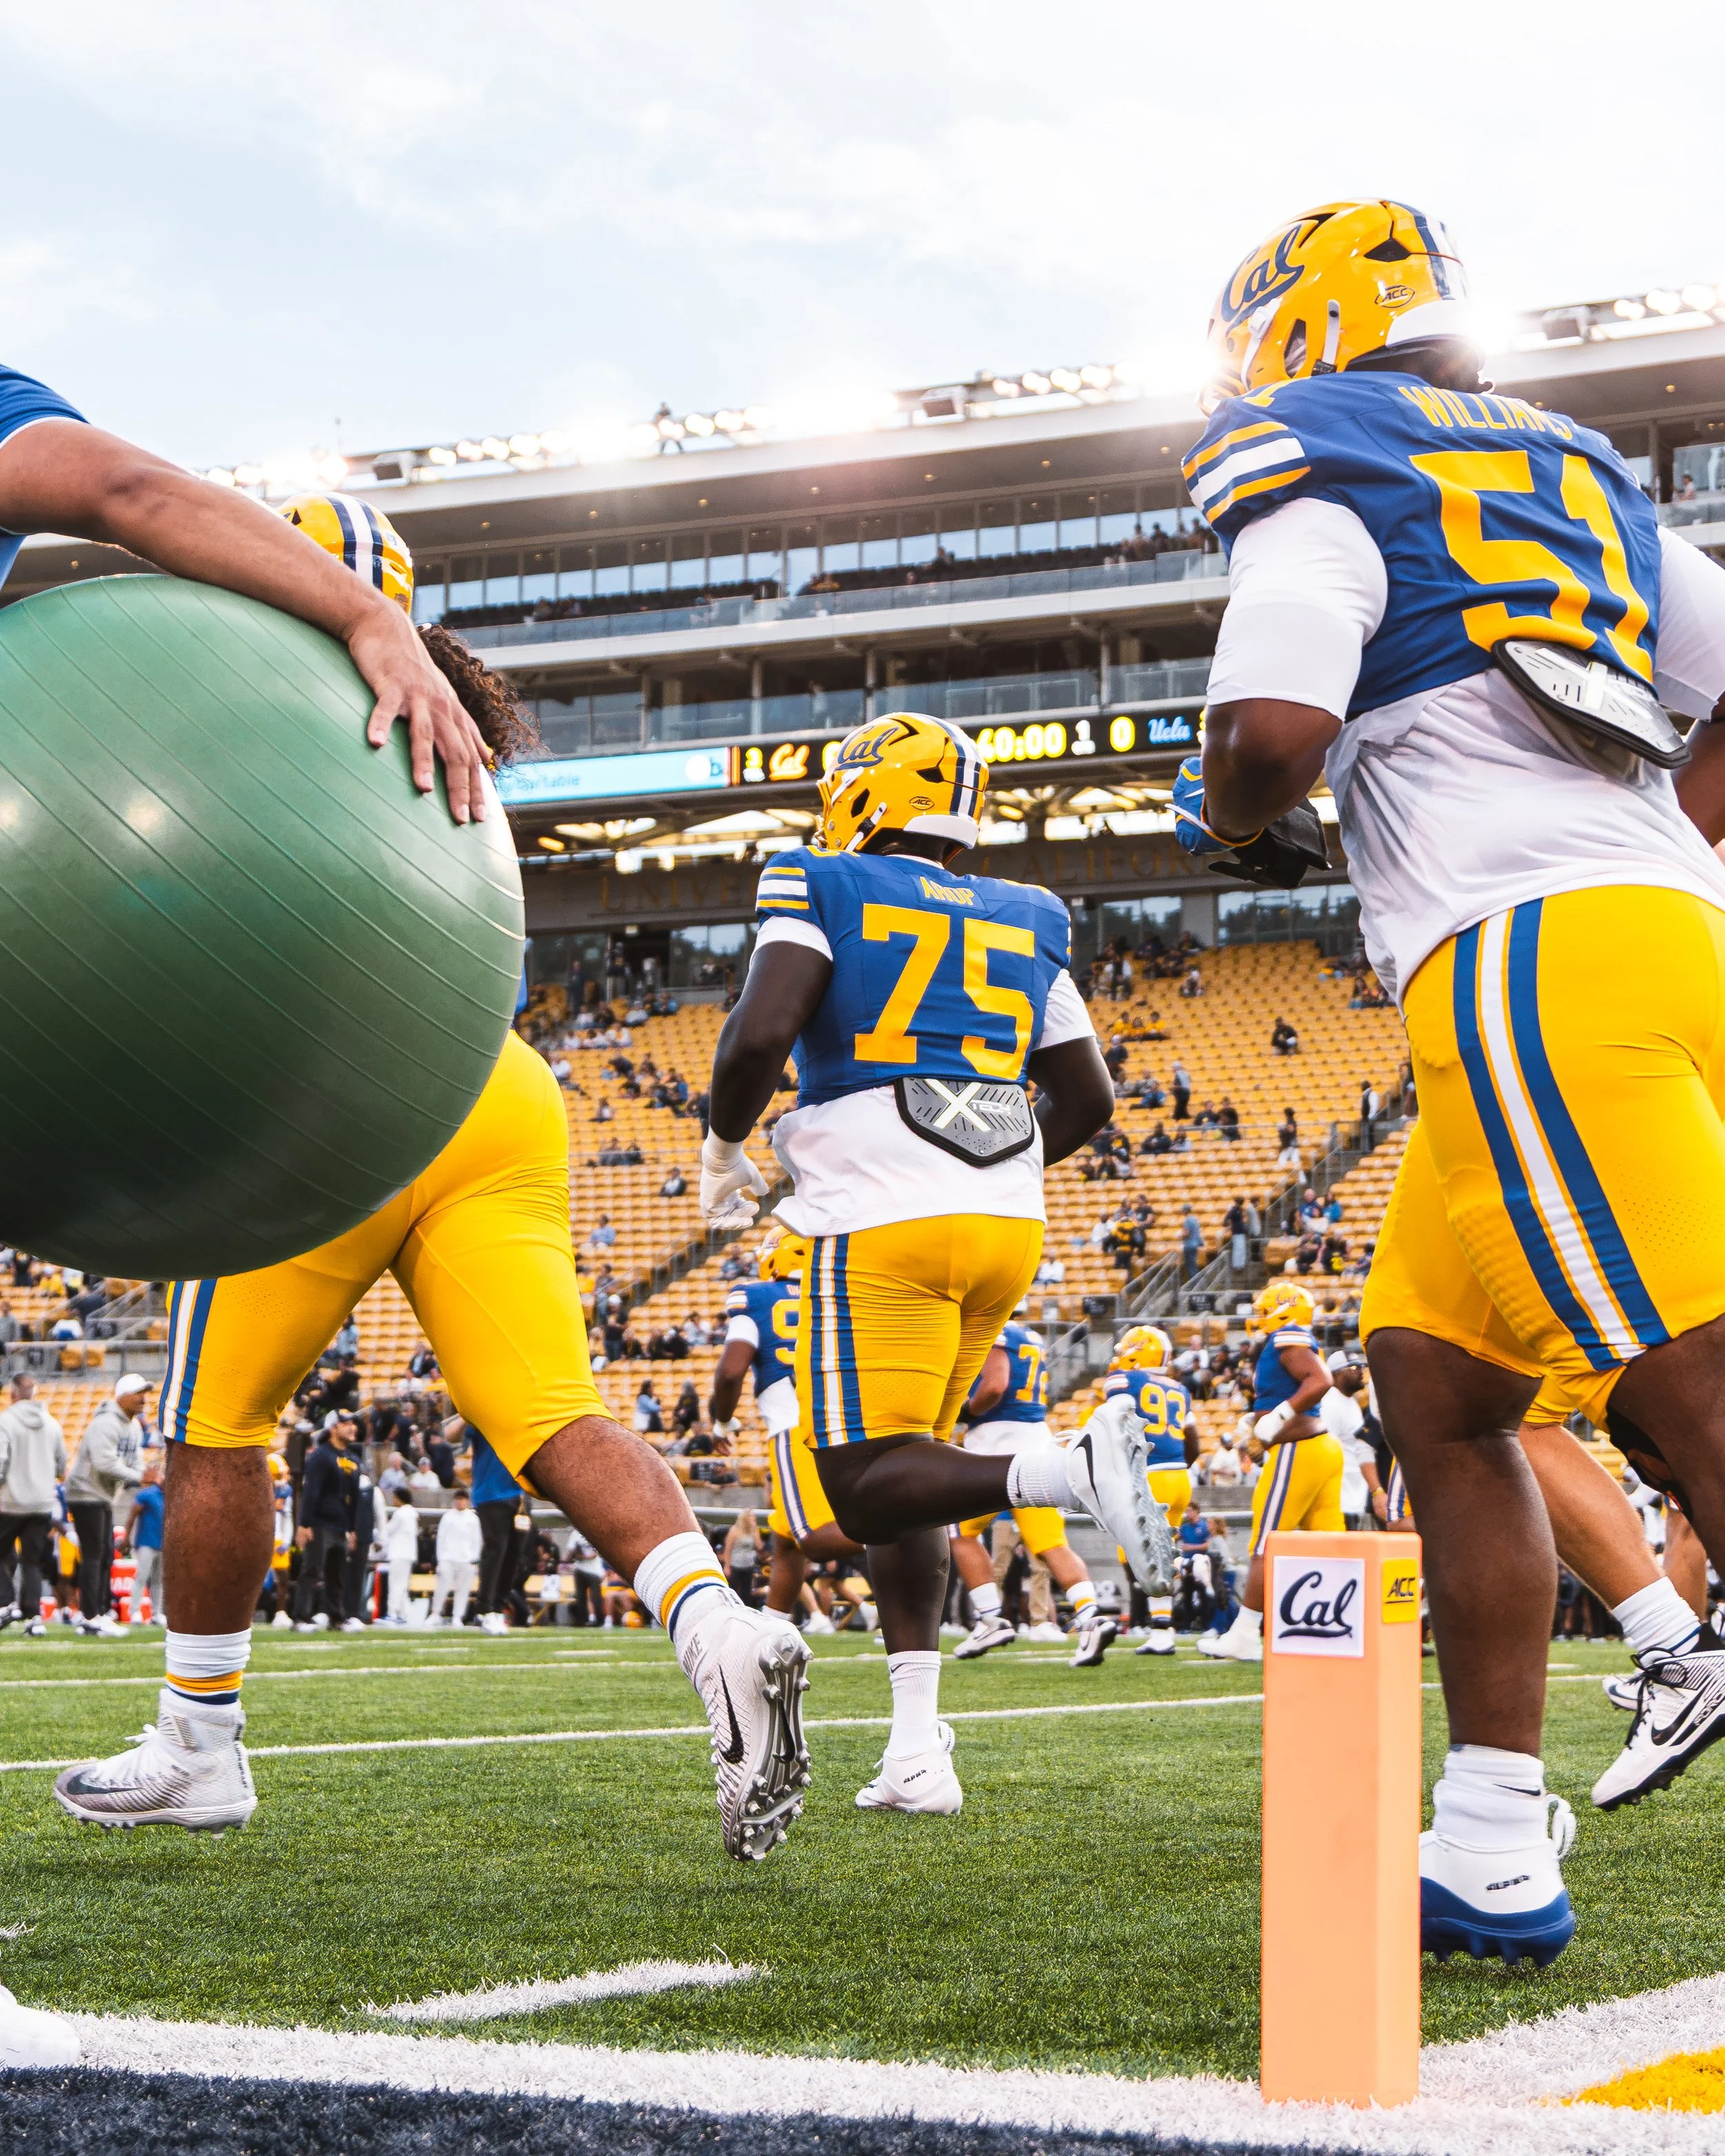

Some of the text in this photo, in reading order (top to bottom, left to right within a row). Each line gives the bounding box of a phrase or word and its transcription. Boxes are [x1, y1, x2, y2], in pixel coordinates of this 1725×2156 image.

[1221, 222, 1304, 333] Cal
[1409, 450, 1653, 685] 51
[769, 743, 810, 780] Cal
[976, 722, 1067, 764] 60:00
[1110, 716, 1136, 752] 0
[833, 725, 900, 772] Cal
[854, 903, 1034, 1080] 75
[771, 1298, 802, 1365] 9
[1140, 1383, 1187, 1441] 93
[1278, 1570, 1357, 1639] Cal
[1387, 1576, 1416, 1598] ACC
